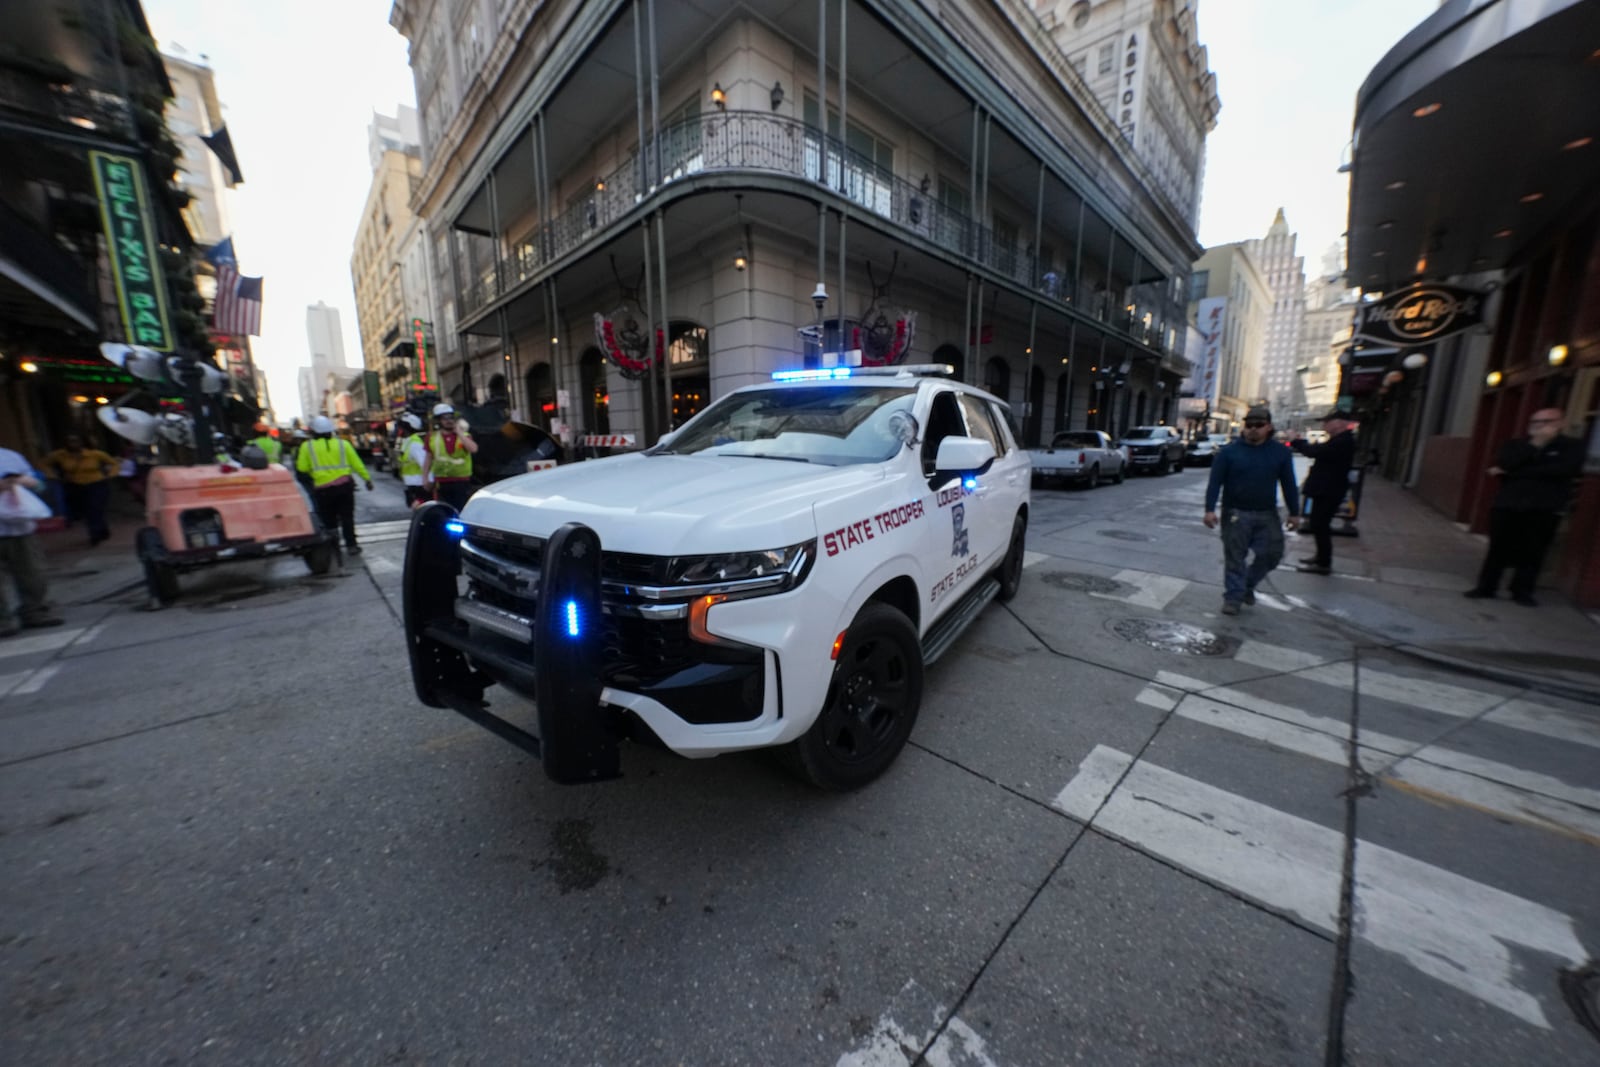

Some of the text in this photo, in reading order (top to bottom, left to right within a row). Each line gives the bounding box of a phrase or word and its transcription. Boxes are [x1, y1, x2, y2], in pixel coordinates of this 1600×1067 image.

[129, 291, 162, 344] BAR
[1366, 300, 1425, 323] Hard
[824, 499, 925, 557] STATE TROOPER
[930, 553, 978, 603] STATE POLICE
